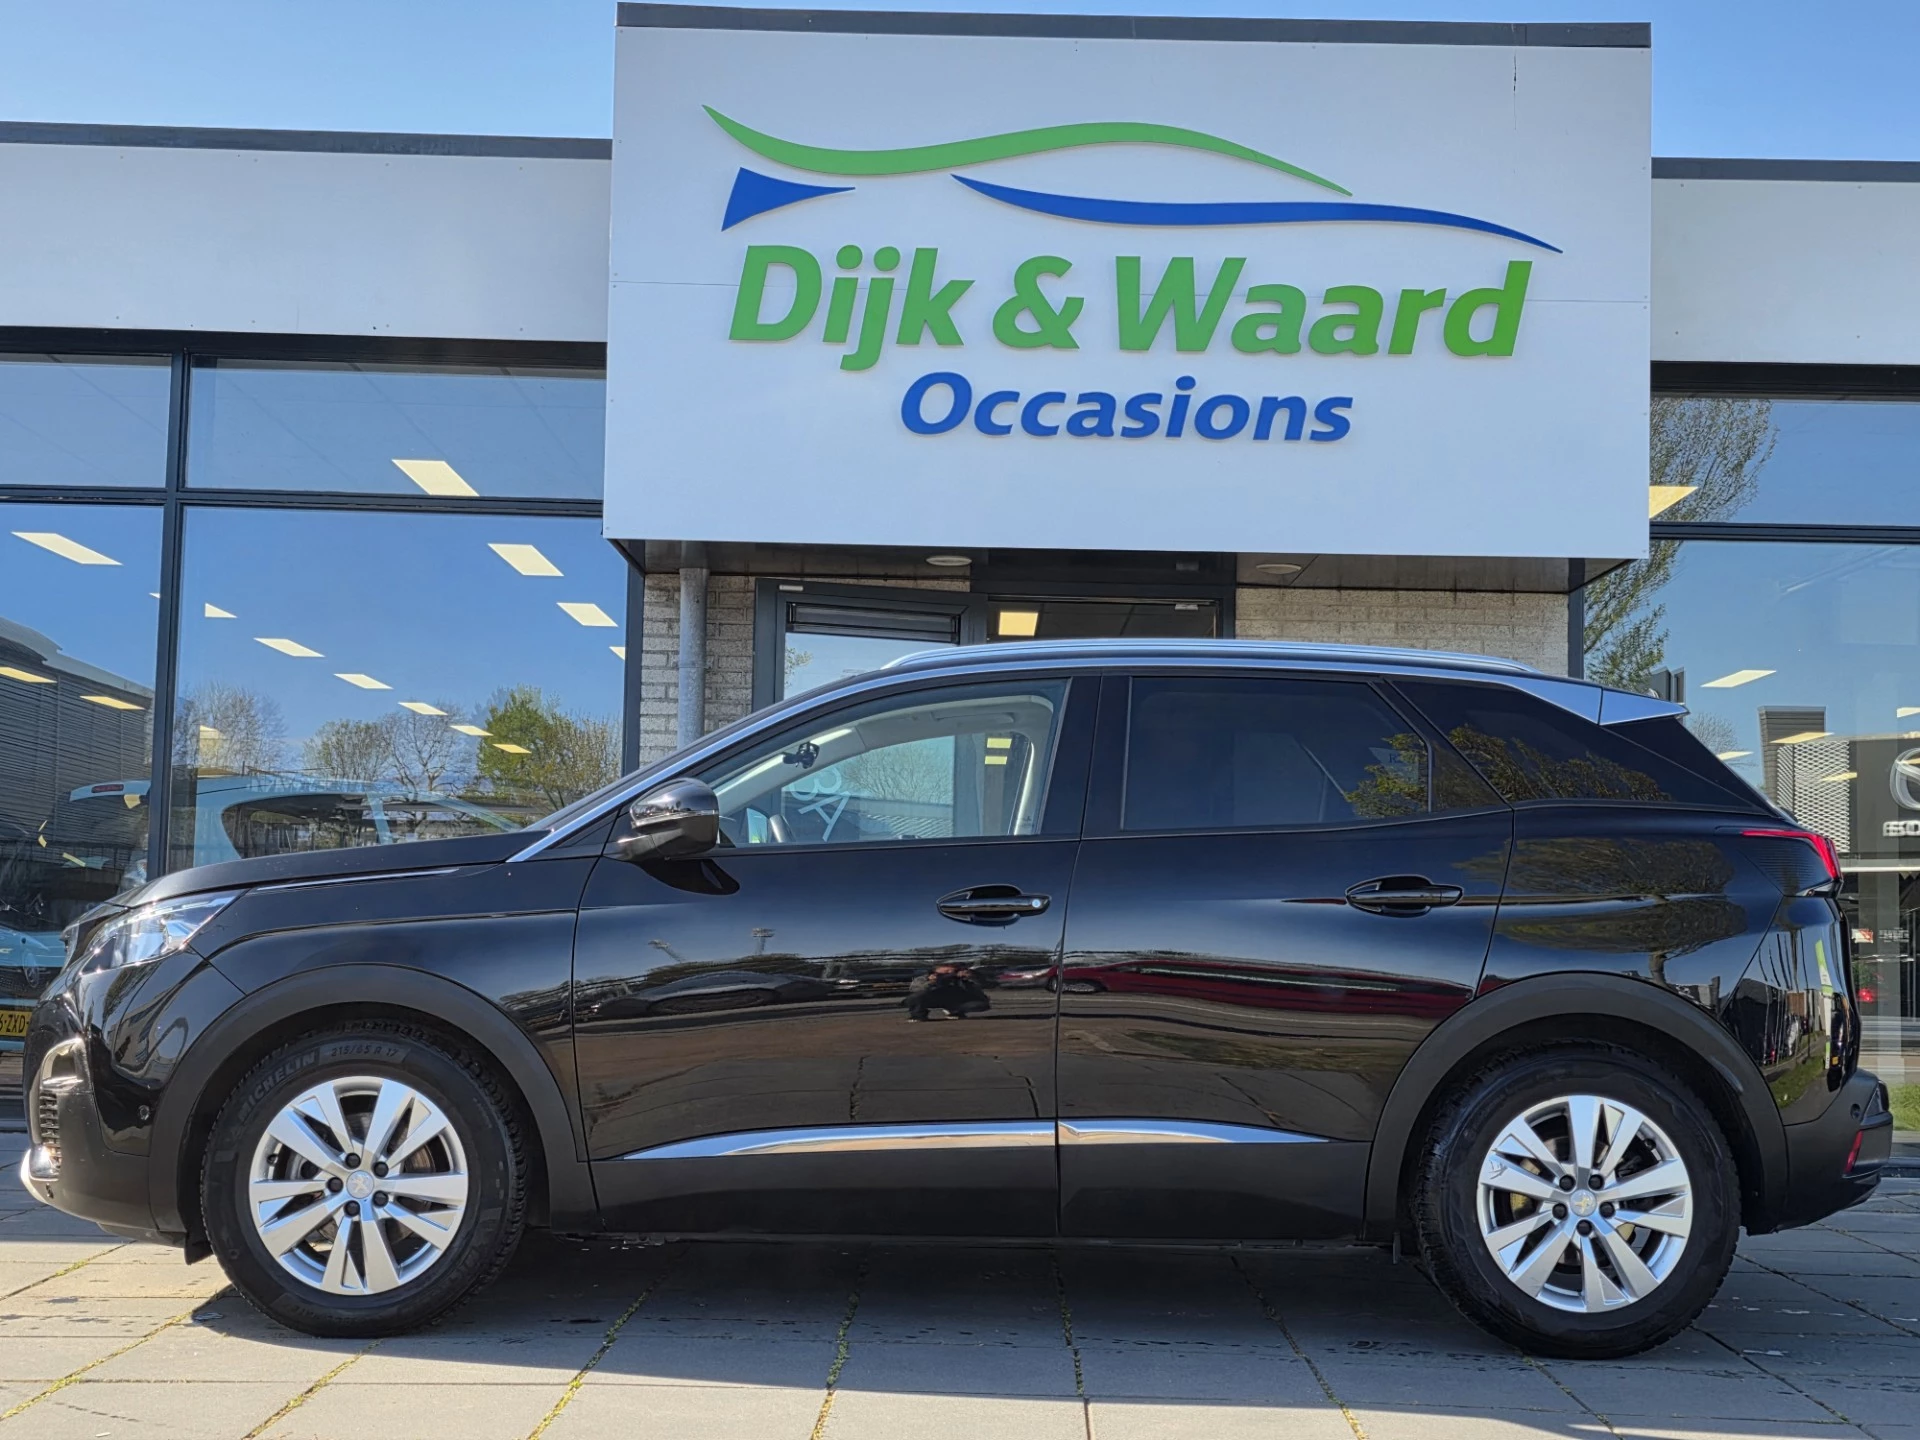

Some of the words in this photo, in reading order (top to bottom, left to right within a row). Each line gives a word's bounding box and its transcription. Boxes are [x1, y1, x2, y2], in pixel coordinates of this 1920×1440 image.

[729, 244, 973, 371] Dijk
[992, 255, 1085, 350] &
[1115, 255, 1532, 357] Waard
[900, 370, 1354, 443] Occasions
[237, 1051, 317, 1123] MICHELIN
